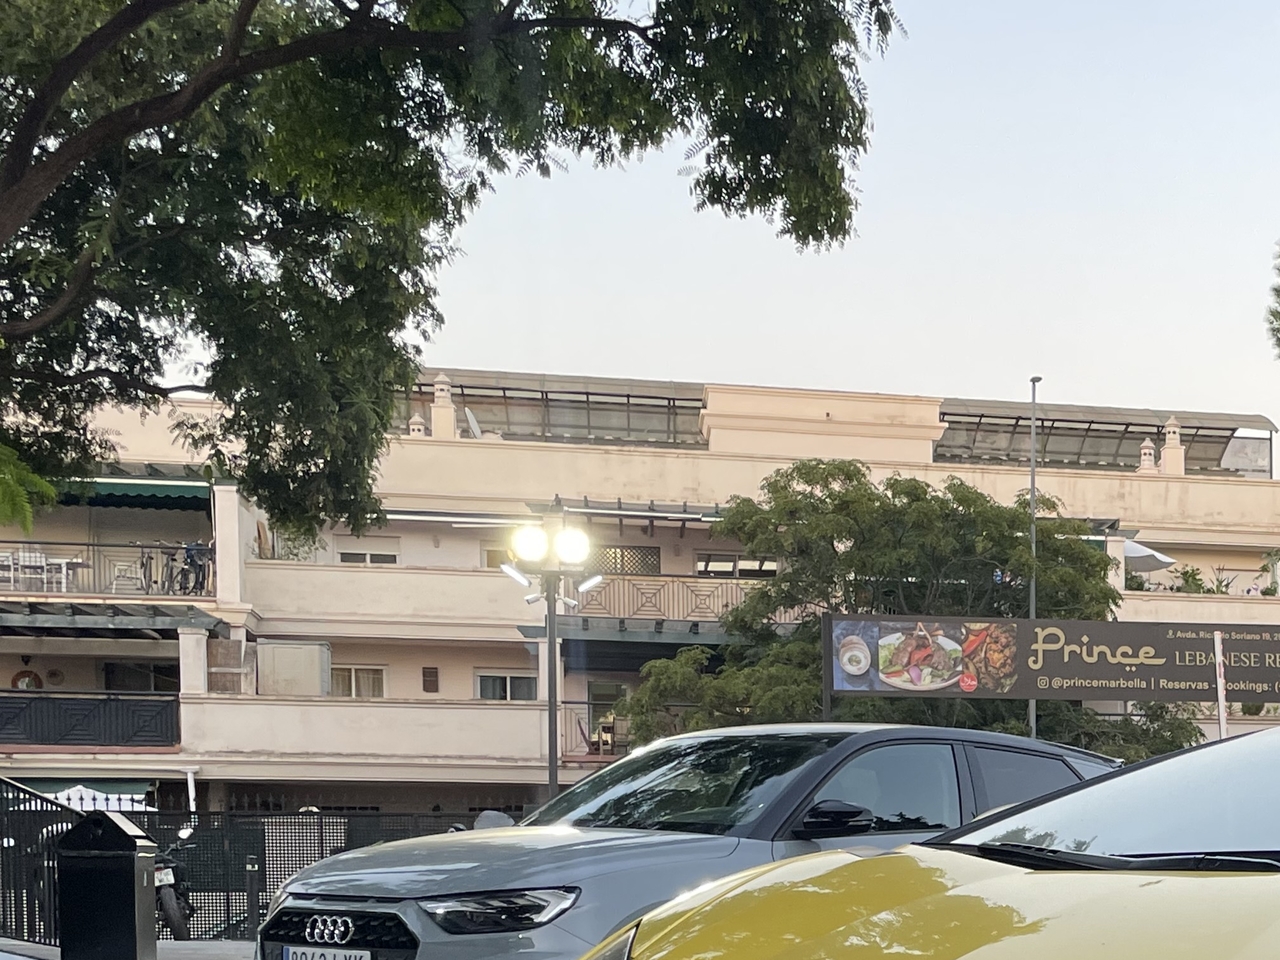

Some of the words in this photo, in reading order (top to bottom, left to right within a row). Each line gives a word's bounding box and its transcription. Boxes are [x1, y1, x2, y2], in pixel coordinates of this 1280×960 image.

[1176, 630, 1198, 639] Avda.
[1231, 632, 1260, 640] Soriano
[1028, 626, 1166, 672] Prince
[1051, 677, 1147, 690] @princemarbella
[1159, 679, 1209, 690] Reservas
[1224, 680, 1272, 693] ookings:
